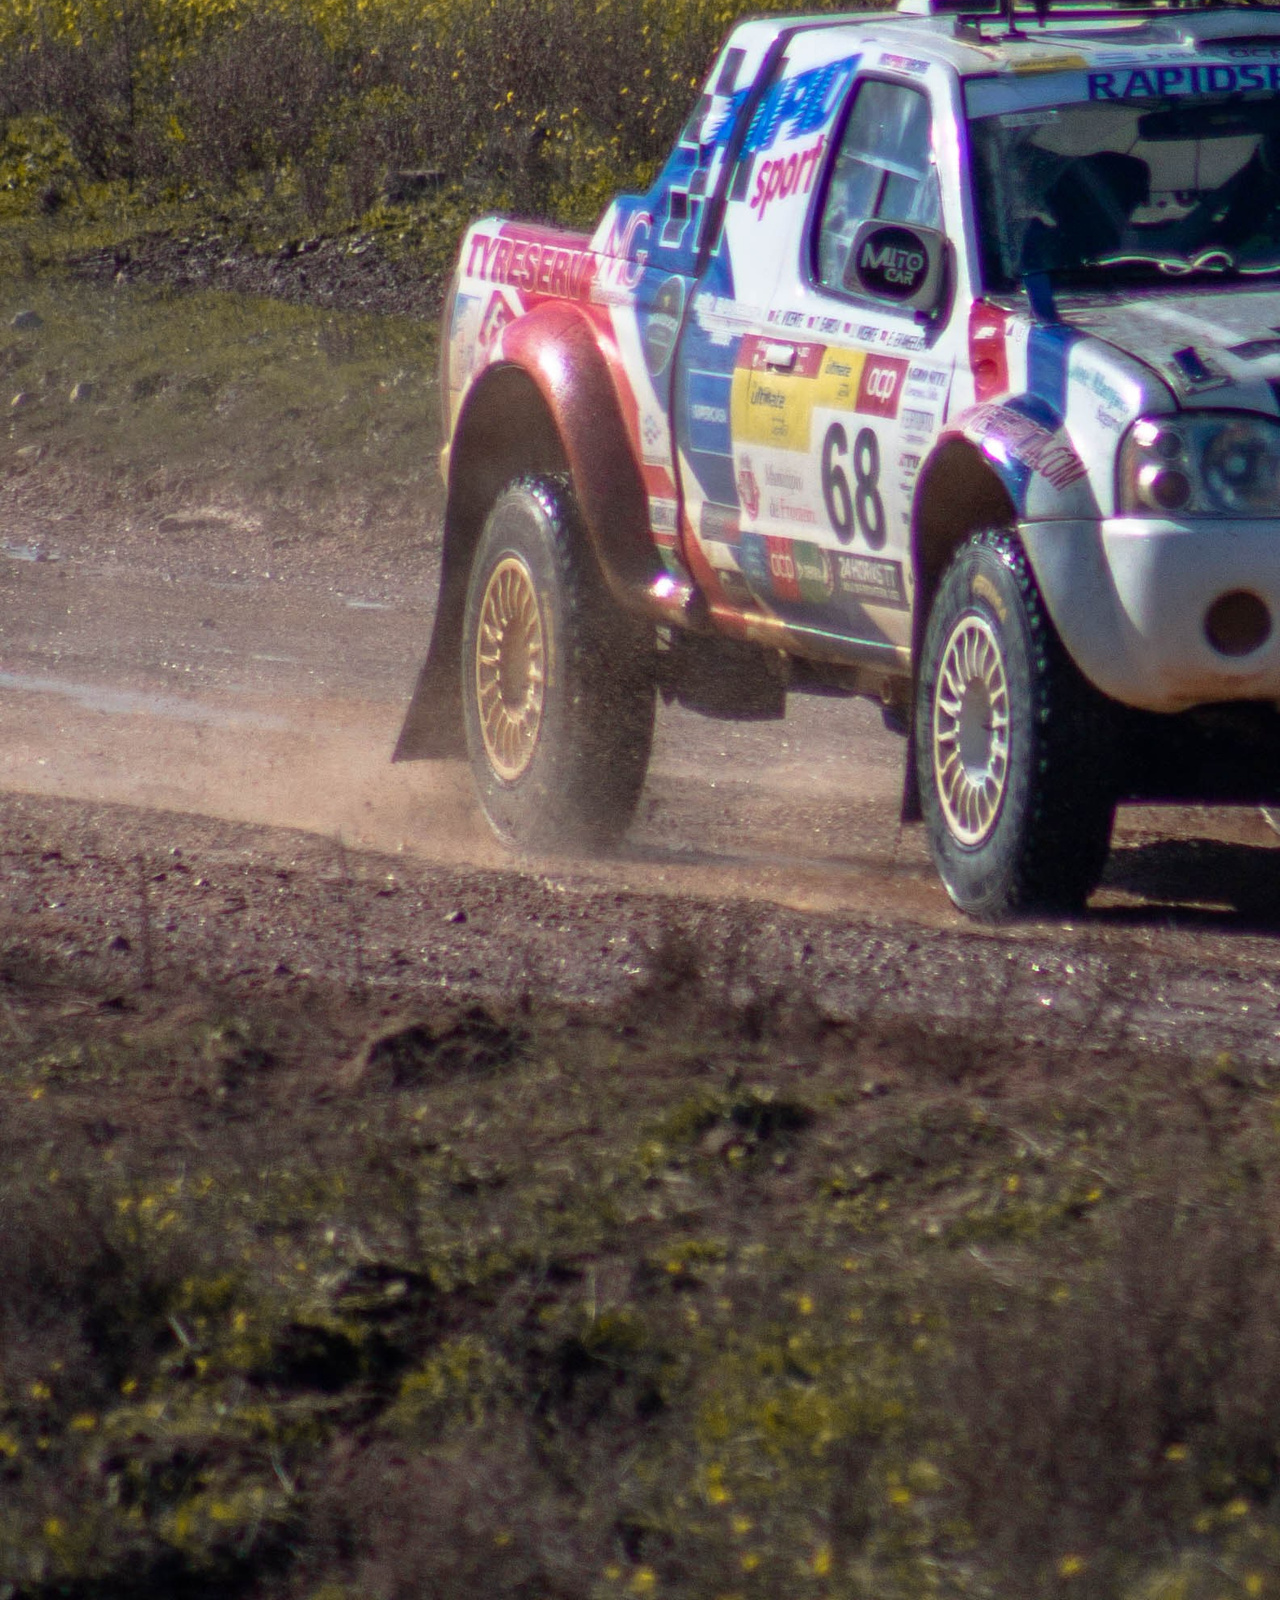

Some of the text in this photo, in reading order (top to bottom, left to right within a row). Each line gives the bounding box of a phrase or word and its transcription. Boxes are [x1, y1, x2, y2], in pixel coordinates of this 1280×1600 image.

[750, 134, 827, 222] sport
[860, 242, 924, 272] MITO
[883, 267, 914, 286] CAR
[866, 366, 898, 404] acp
[821, 421, 887, 551] 68
